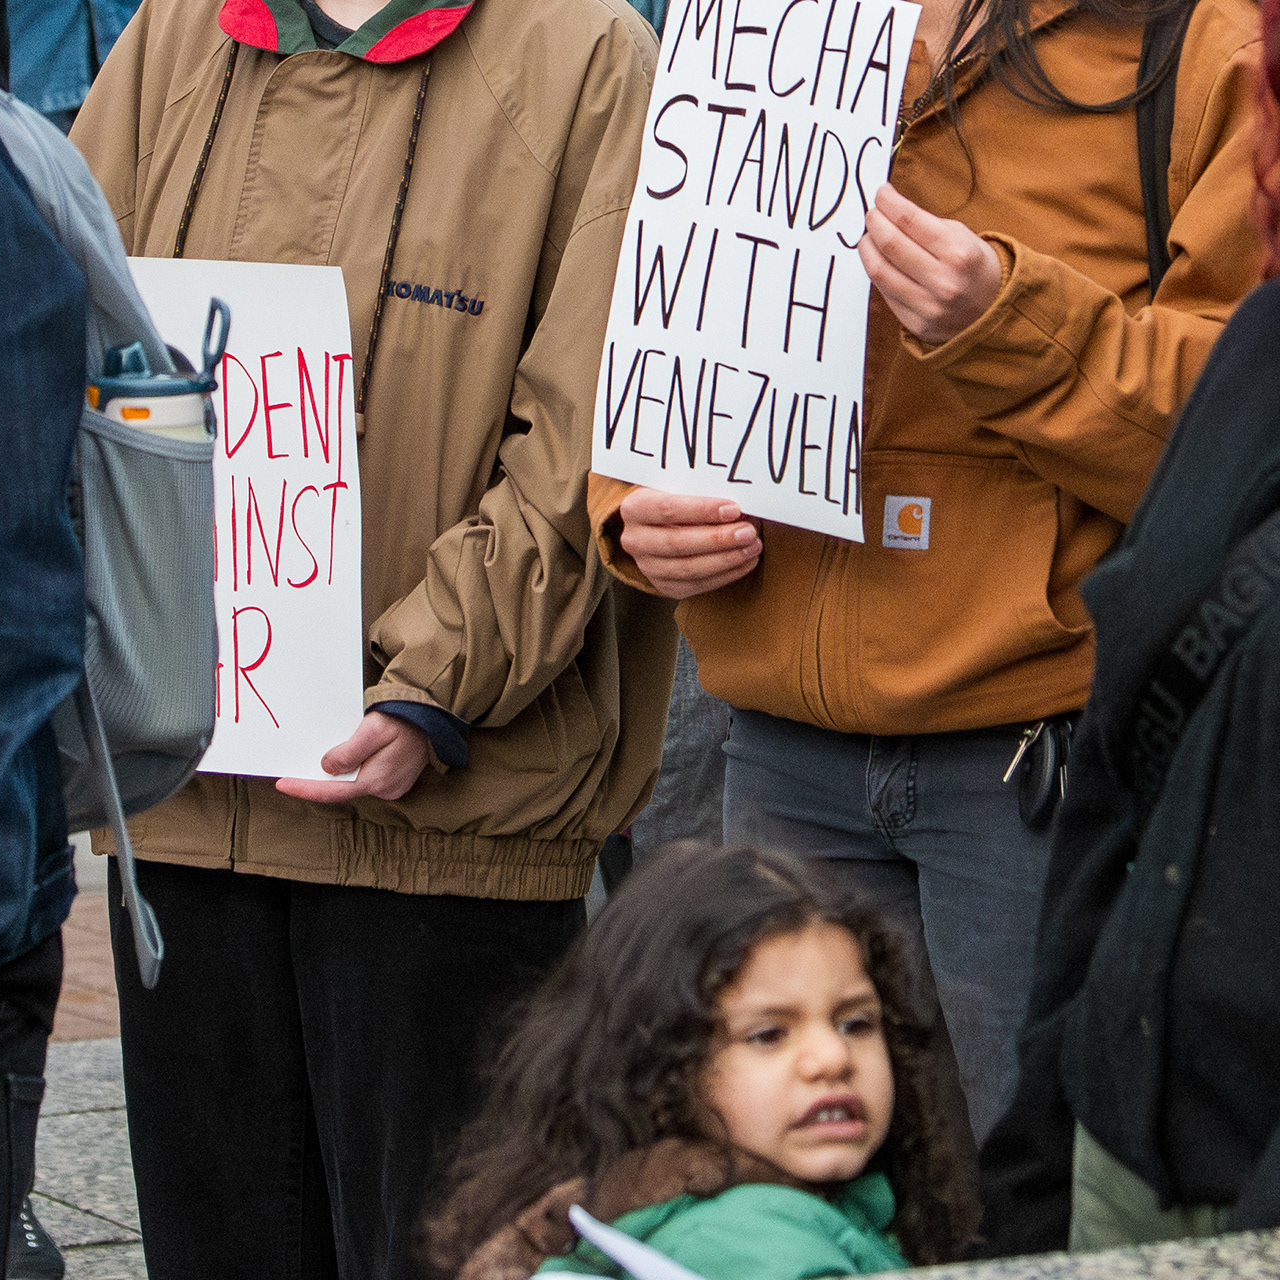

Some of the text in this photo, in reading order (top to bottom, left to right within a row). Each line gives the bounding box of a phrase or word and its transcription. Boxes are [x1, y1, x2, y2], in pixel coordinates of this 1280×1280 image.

[646, 94, 882, 249] STANDS
[633, 220, 835, 362] WITH
[605, 341, 862, 516] VENEZUELA
[214, 474, 348, 592] INST
